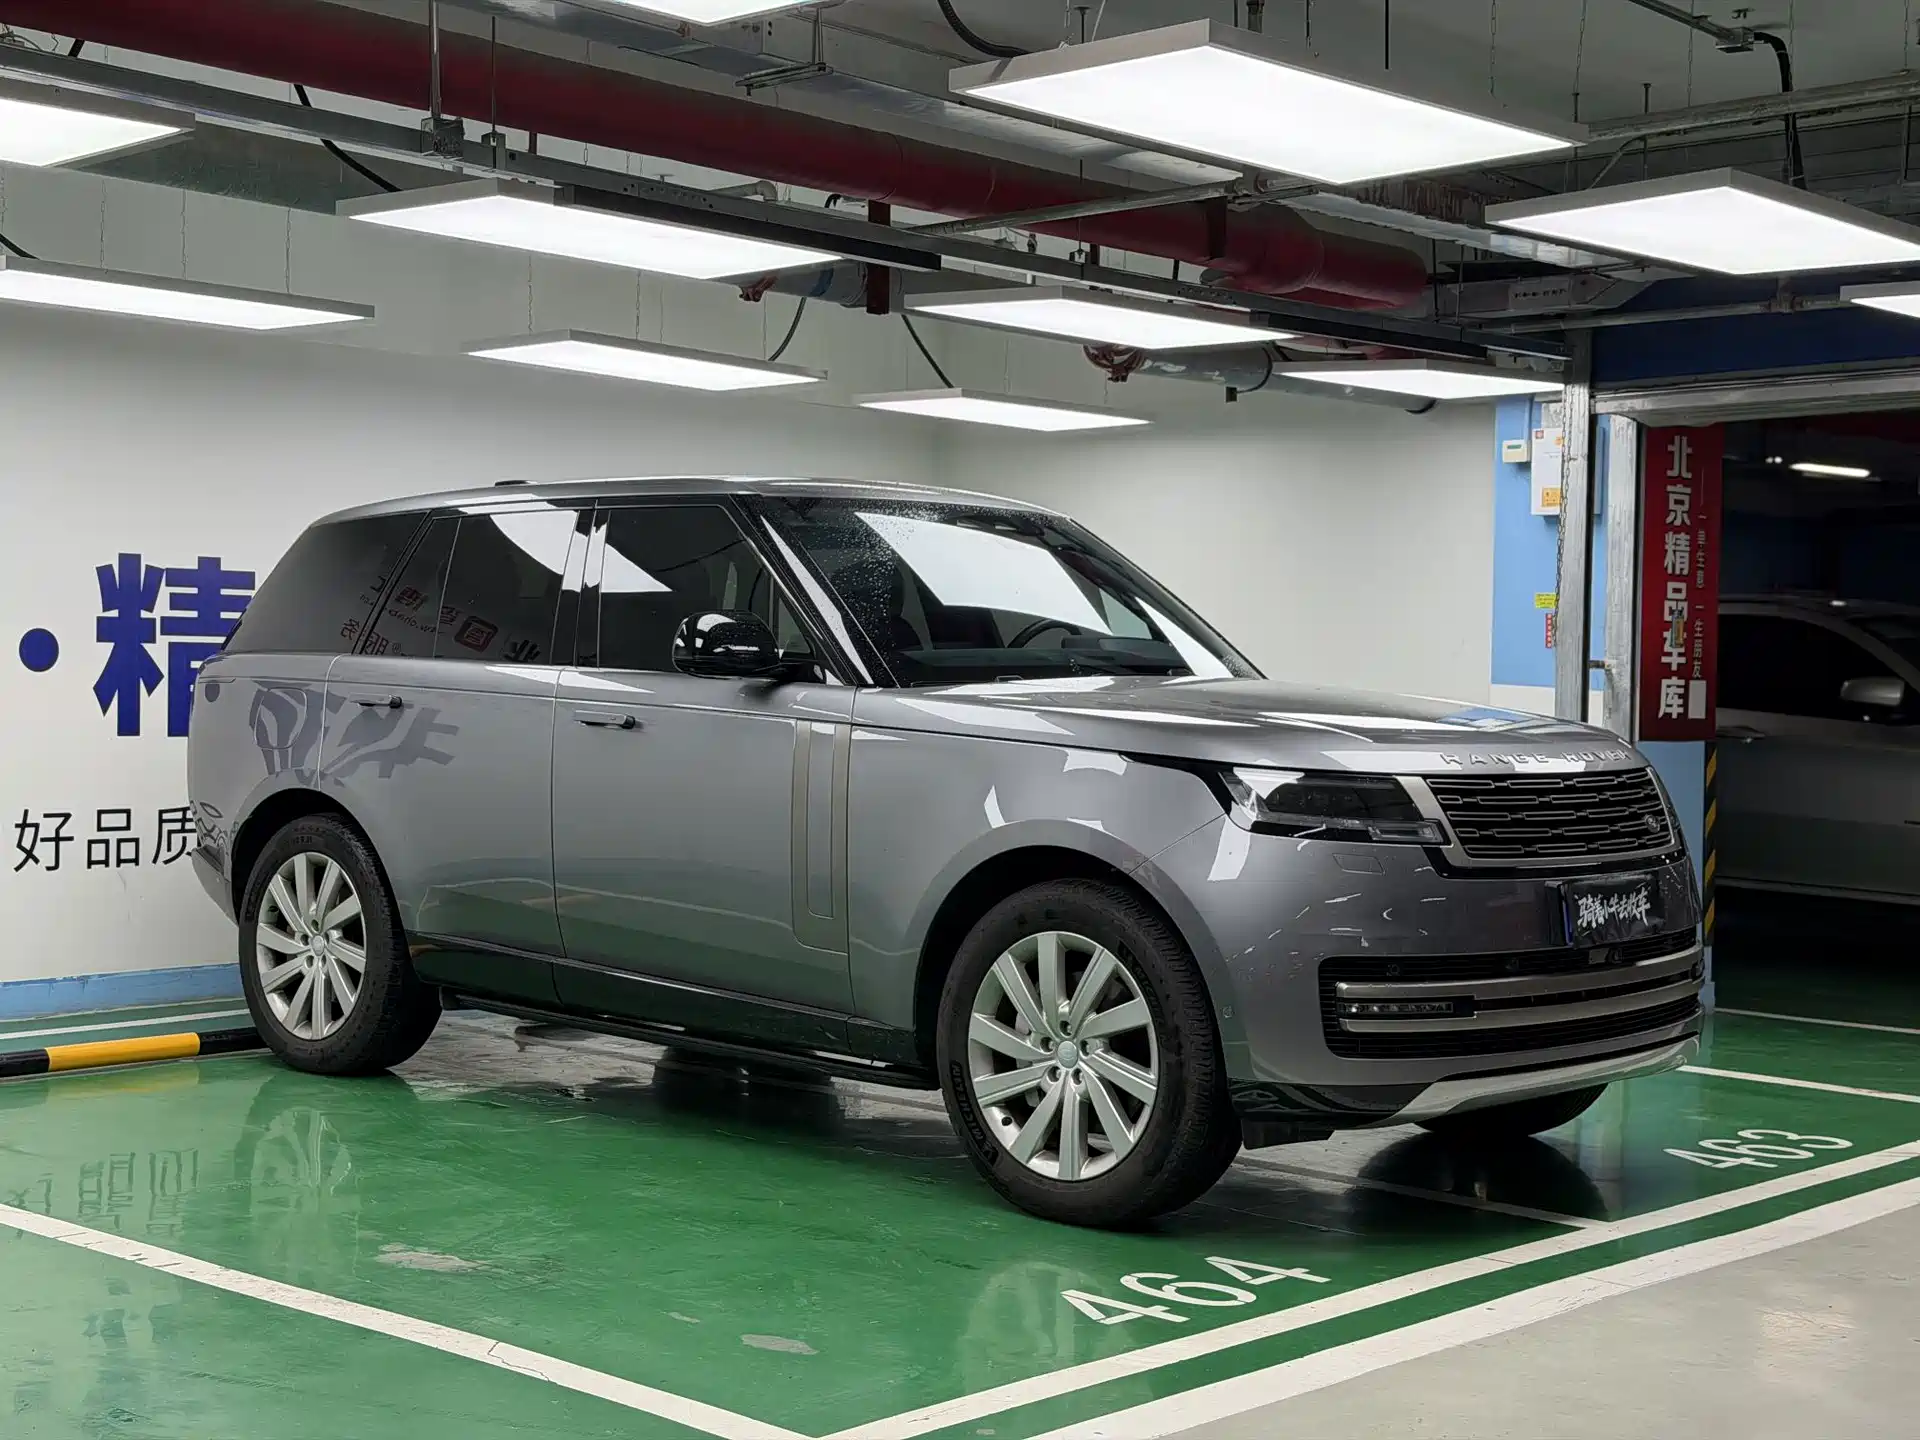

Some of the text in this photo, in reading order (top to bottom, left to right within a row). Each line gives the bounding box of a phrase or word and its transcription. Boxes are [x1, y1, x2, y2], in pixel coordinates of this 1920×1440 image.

[1658, 435, 1692, 720] 北京精品车库
[1440, 749, 1632, 766] RANGE ROVER
[13, 807, 198, 872] 好品质
[1663, 1129, 1853, 1168] 463
[1061, 1256, 1332, 1325] 464
